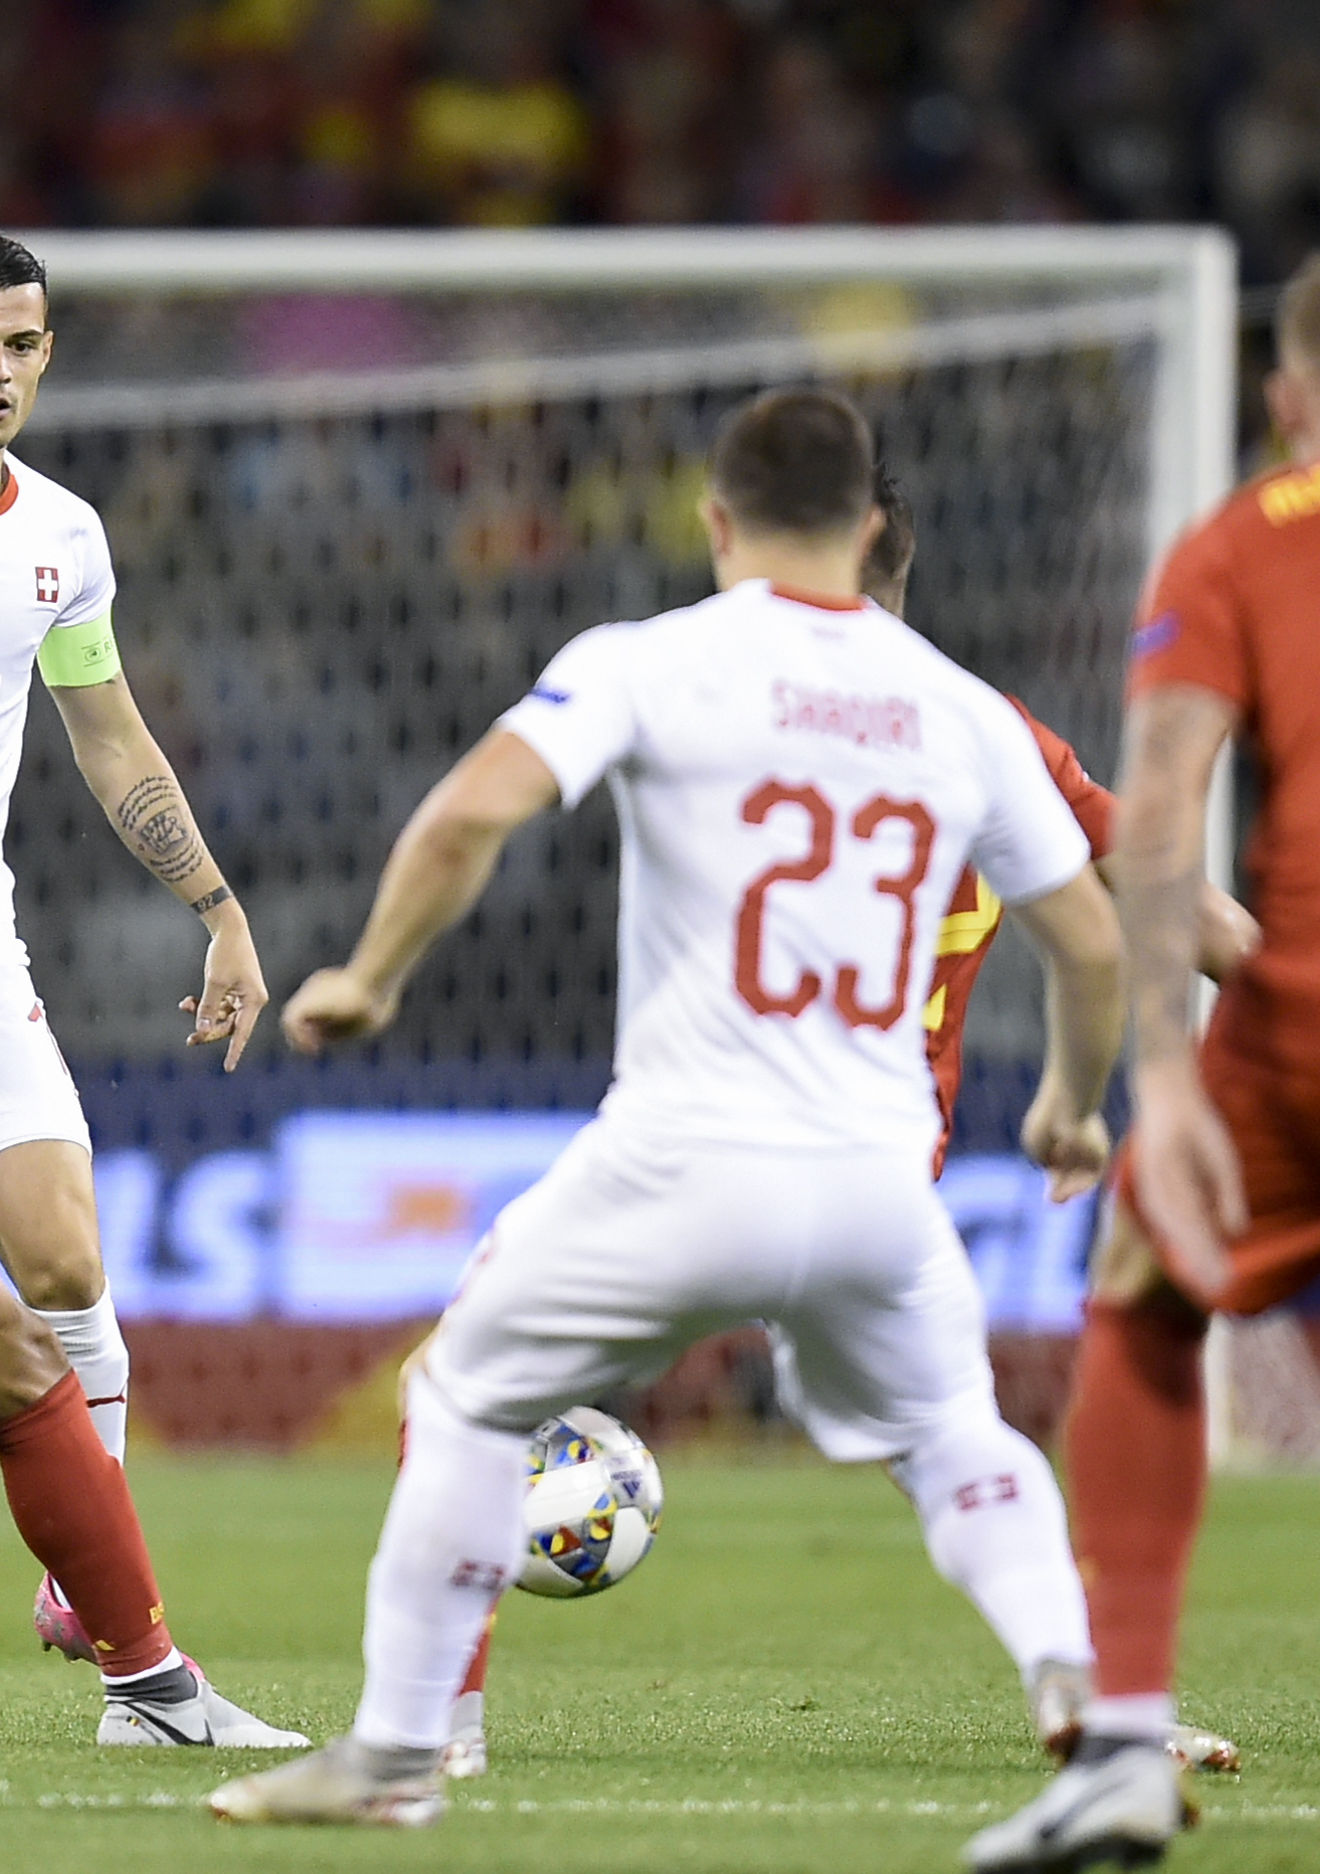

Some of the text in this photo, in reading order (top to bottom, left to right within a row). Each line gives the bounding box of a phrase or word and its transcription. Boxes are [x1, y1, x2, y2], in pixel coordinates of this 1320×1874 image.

[197, 894, 215, 914] 92
[735, 776, 937, 1031] 23
[91, 1150, 276, 1322] LS
